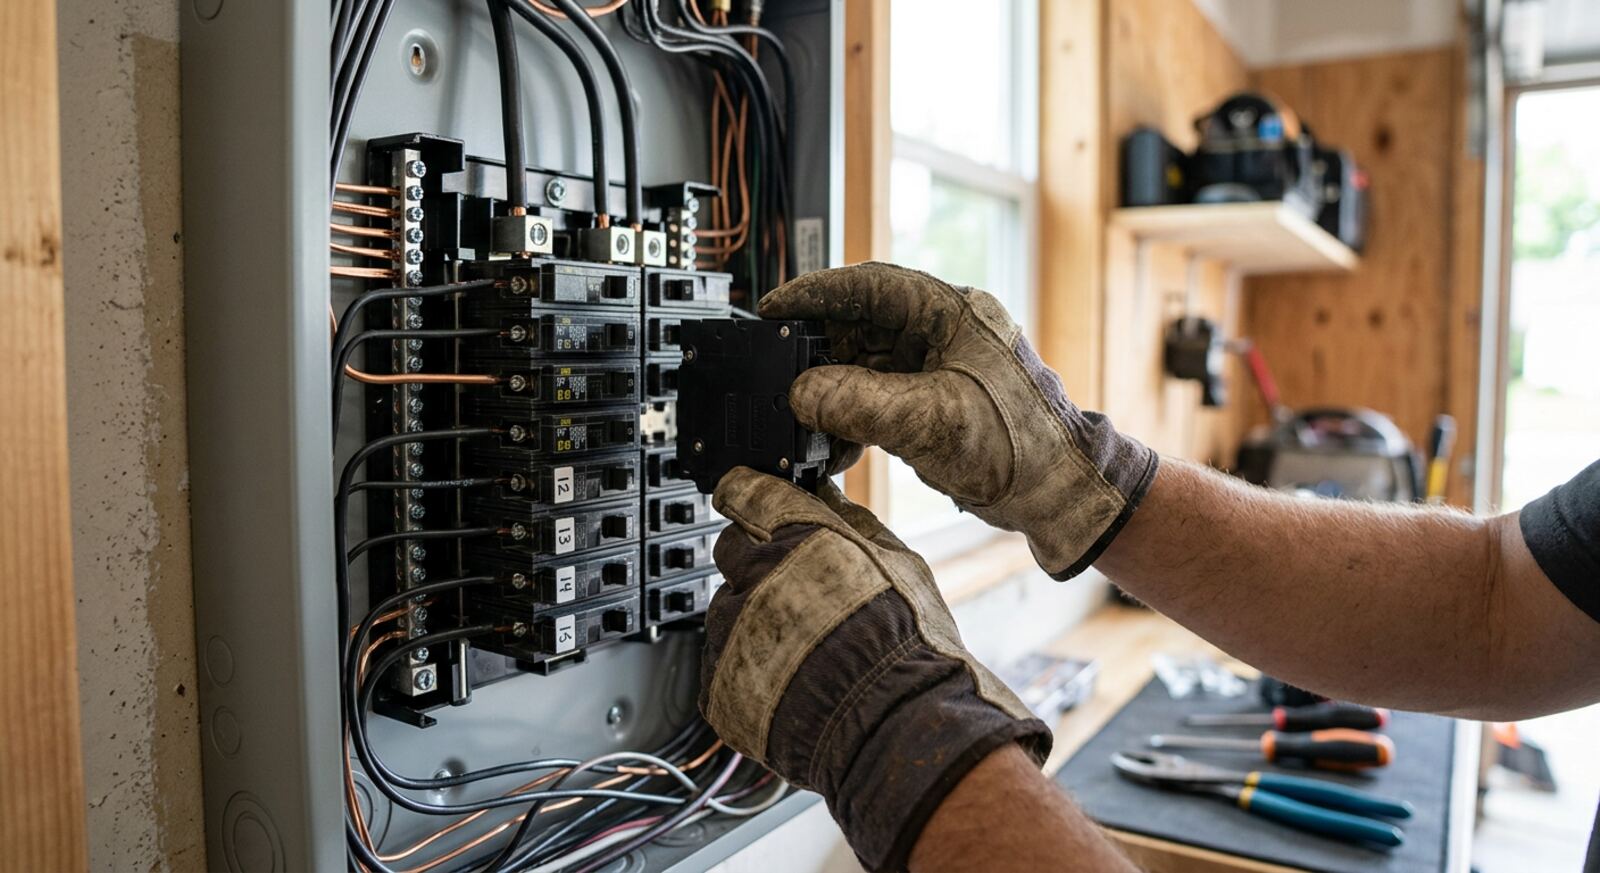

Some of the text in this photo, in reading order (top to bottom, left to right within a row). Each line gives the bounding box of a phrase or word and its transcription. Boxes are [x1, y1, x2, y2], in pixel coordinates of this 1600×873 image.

[557, 477, 570, 496] 12
[558, 527, 571, 546] 13
[559, 576, 573, 593] 14
[558, 626, 572, 643] 15
